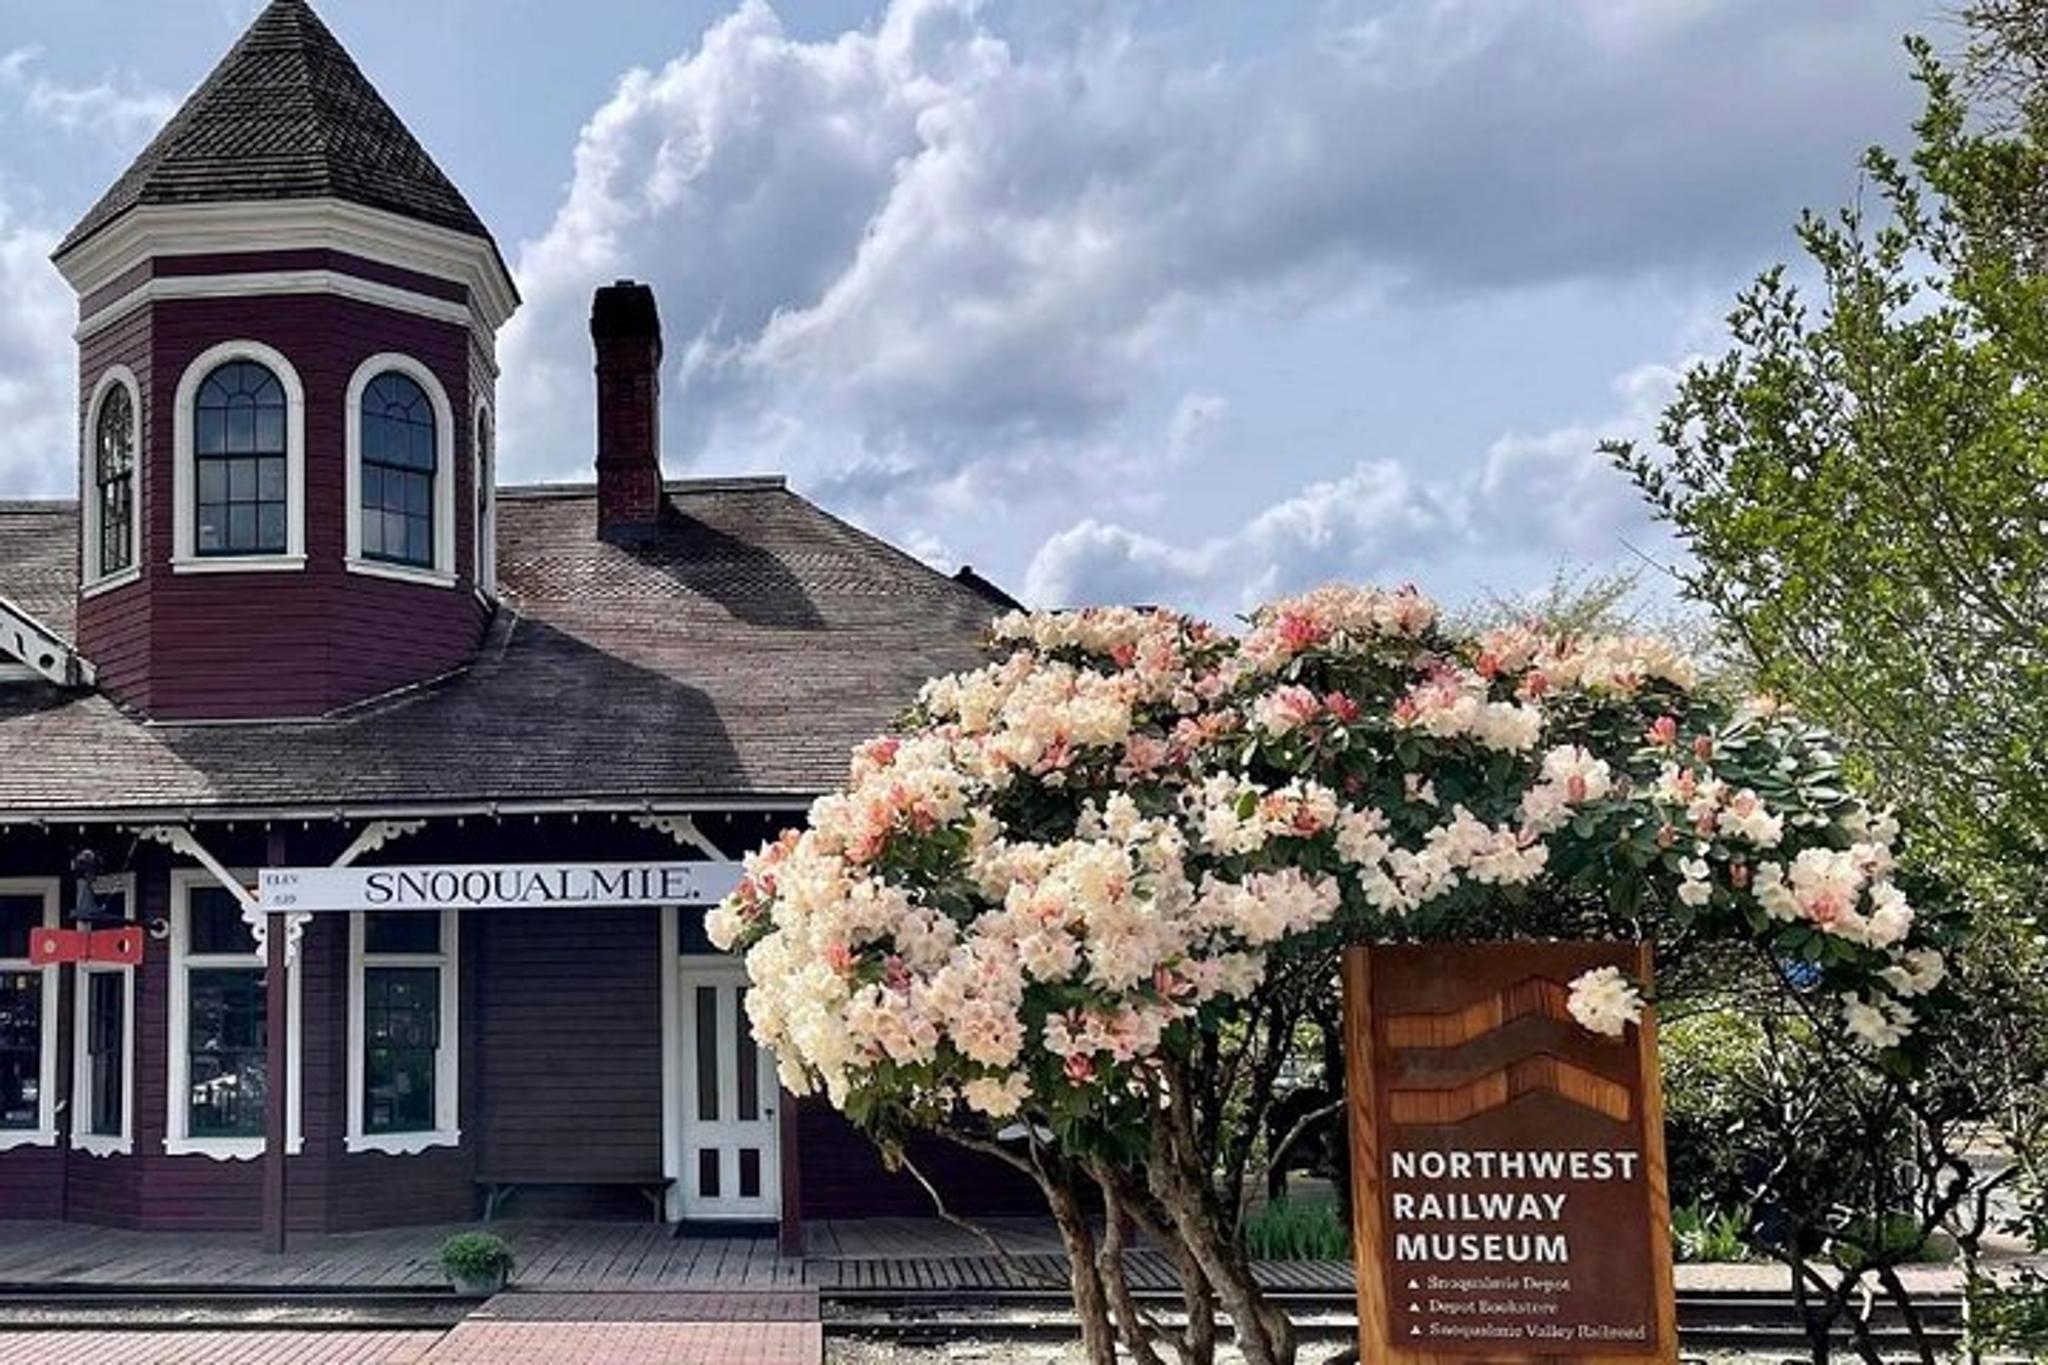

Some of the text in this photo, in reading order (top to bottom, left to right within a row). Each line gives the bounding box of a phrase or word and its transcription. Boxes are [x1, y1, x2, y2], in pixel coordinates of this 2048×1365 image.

[364, 868, 701, 904] SNOQUALMIE.
[1392, 1151, 1638, 1179] NORTHWEST
[1393, 1193, 1567, 1220] RAILWAY
[1396, 1234, 1568, 1262] MUSEUM
[1427, 1275, 1570, 1292] Snoqualmie Depot
[1429, 1299, 1559, 1315] Depot Bookstore
[1526, 1324, 1574, 1340] Valley
